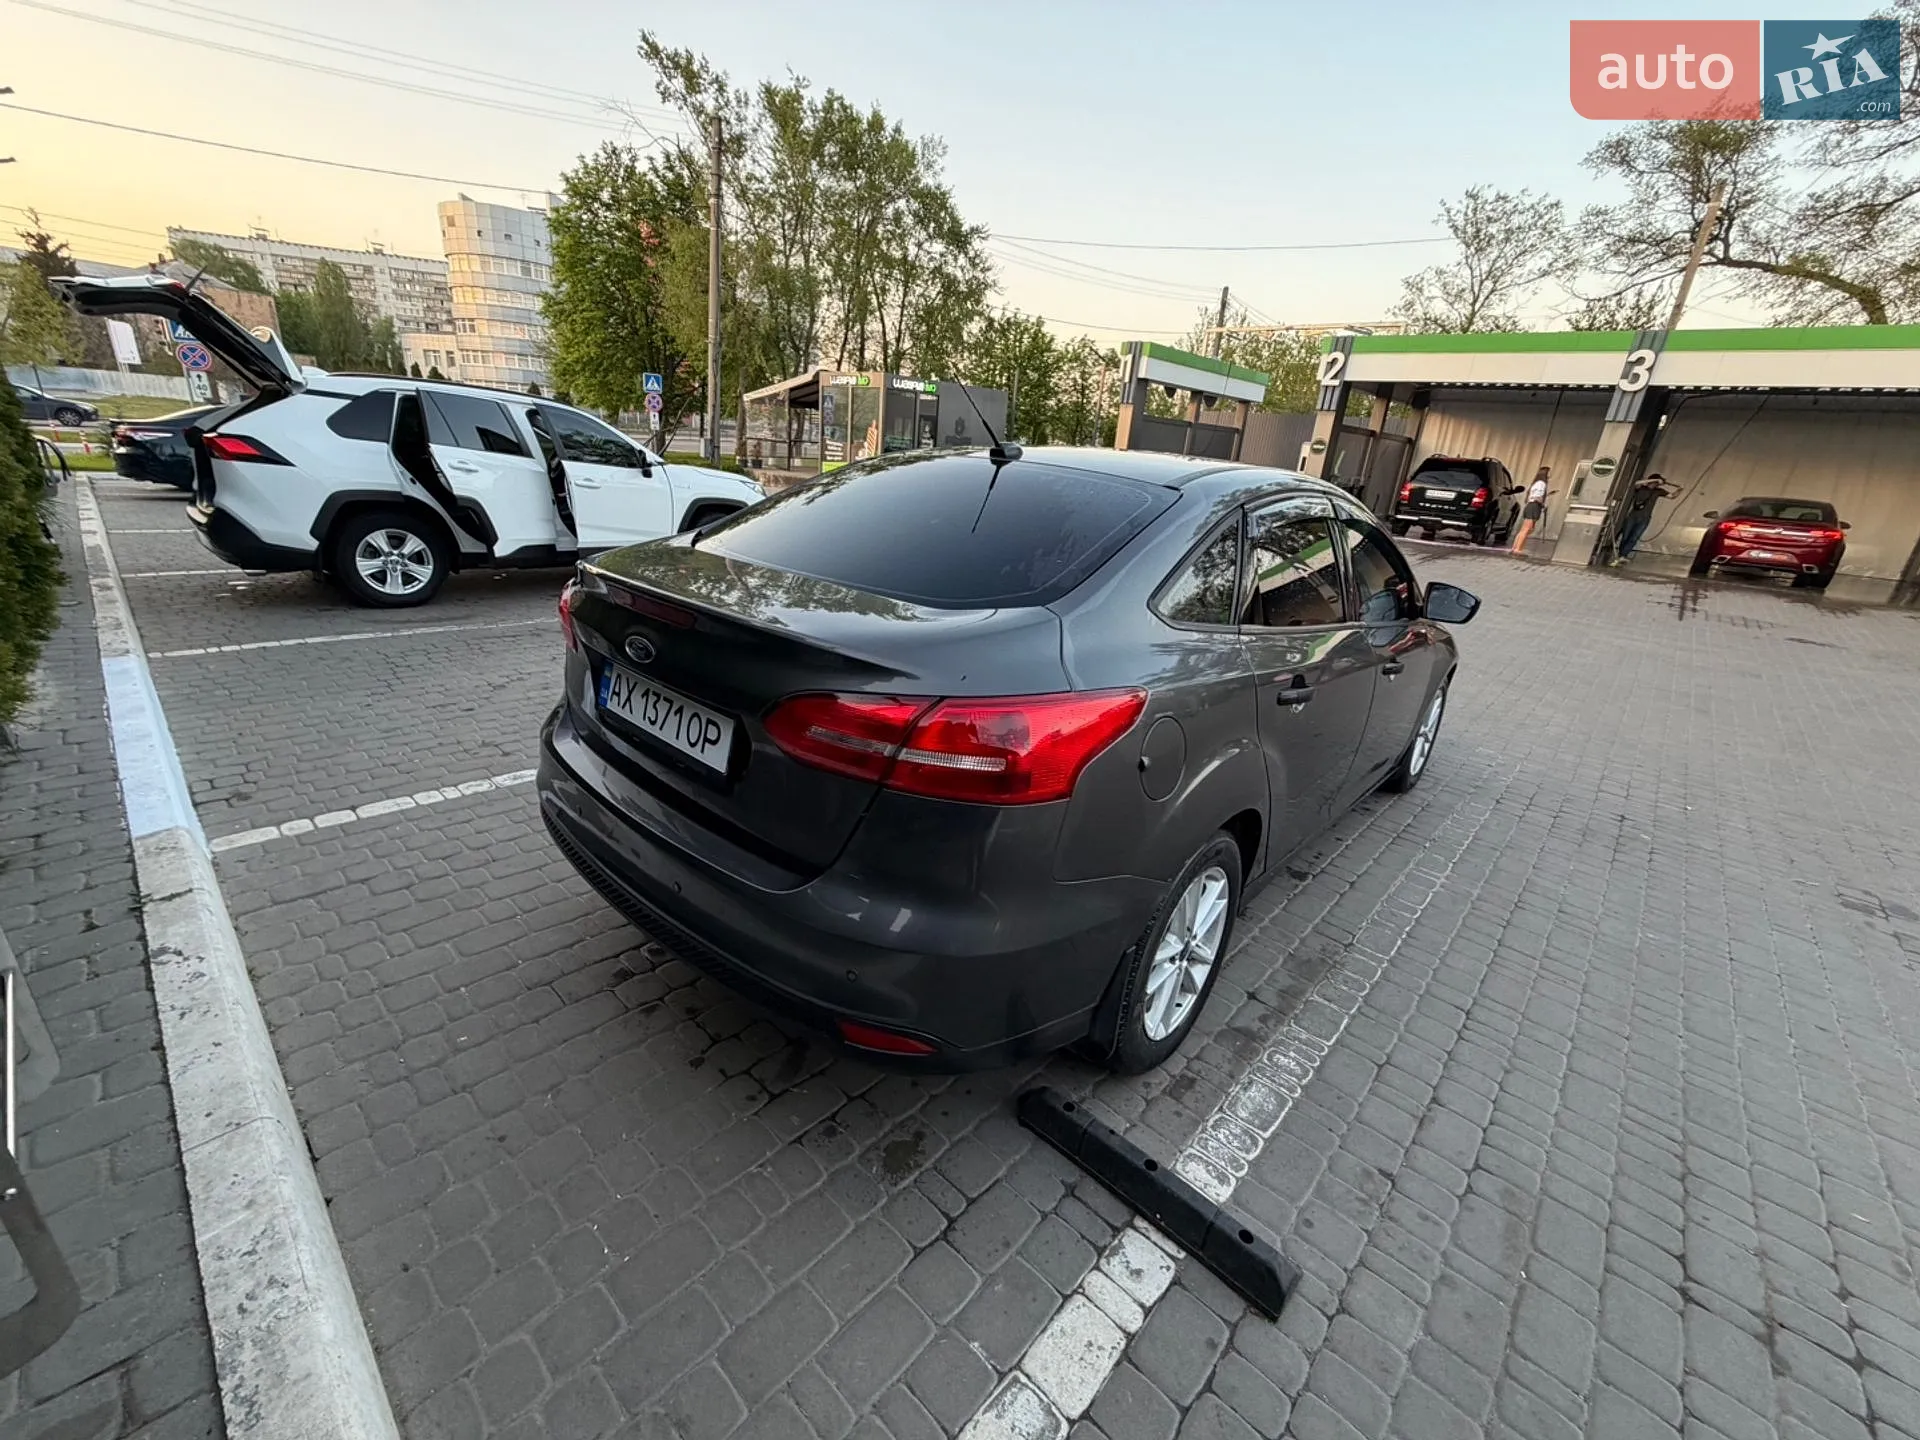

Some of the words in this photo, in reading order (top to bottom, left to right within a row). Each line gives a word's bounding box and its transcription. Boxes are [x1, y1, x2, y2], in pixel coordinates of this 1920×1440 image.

[1321, 351, 1345, 386] 2
[1618, 349, 1656, 391] 3
[609, 672, 638, 714] AX
